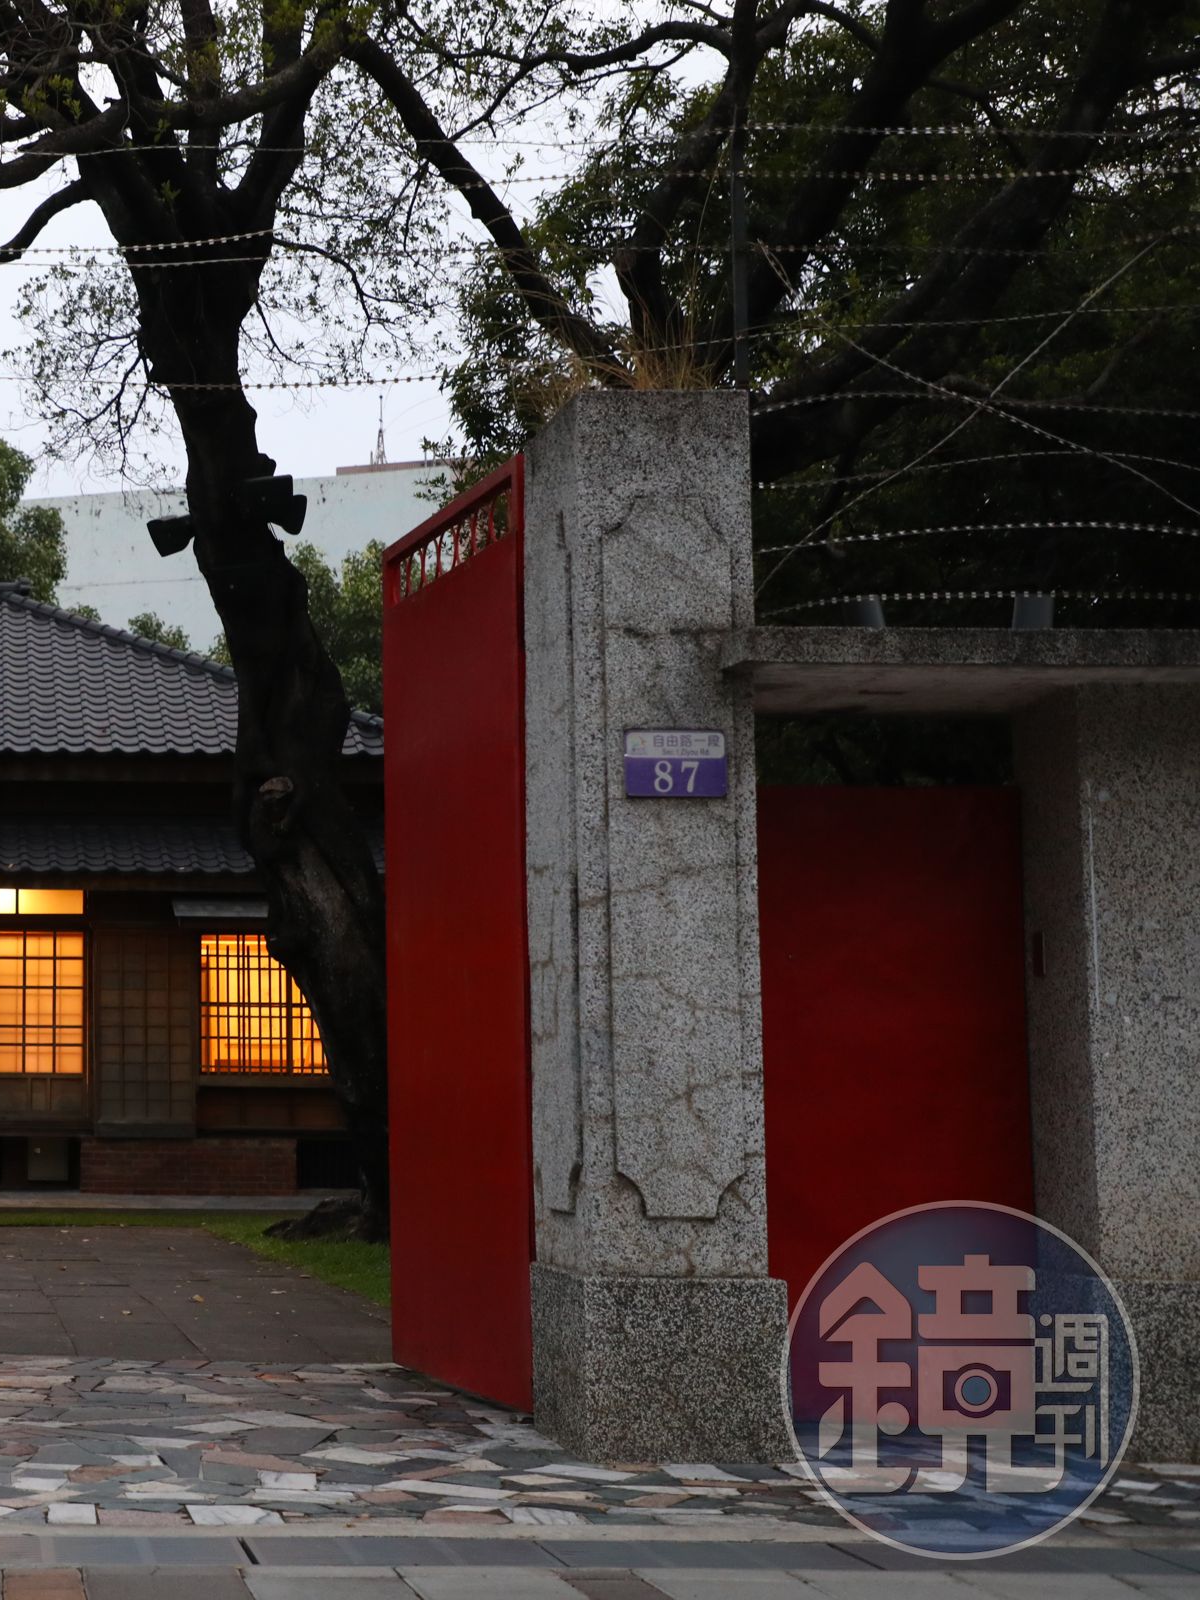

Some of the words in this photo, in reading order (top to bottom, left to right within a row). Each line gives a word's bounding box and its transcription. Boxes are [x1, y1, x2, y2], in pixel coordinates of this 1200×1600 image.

[653, 734, 720, 747] 自由路一段
[654, 760, 700, 793] 87
